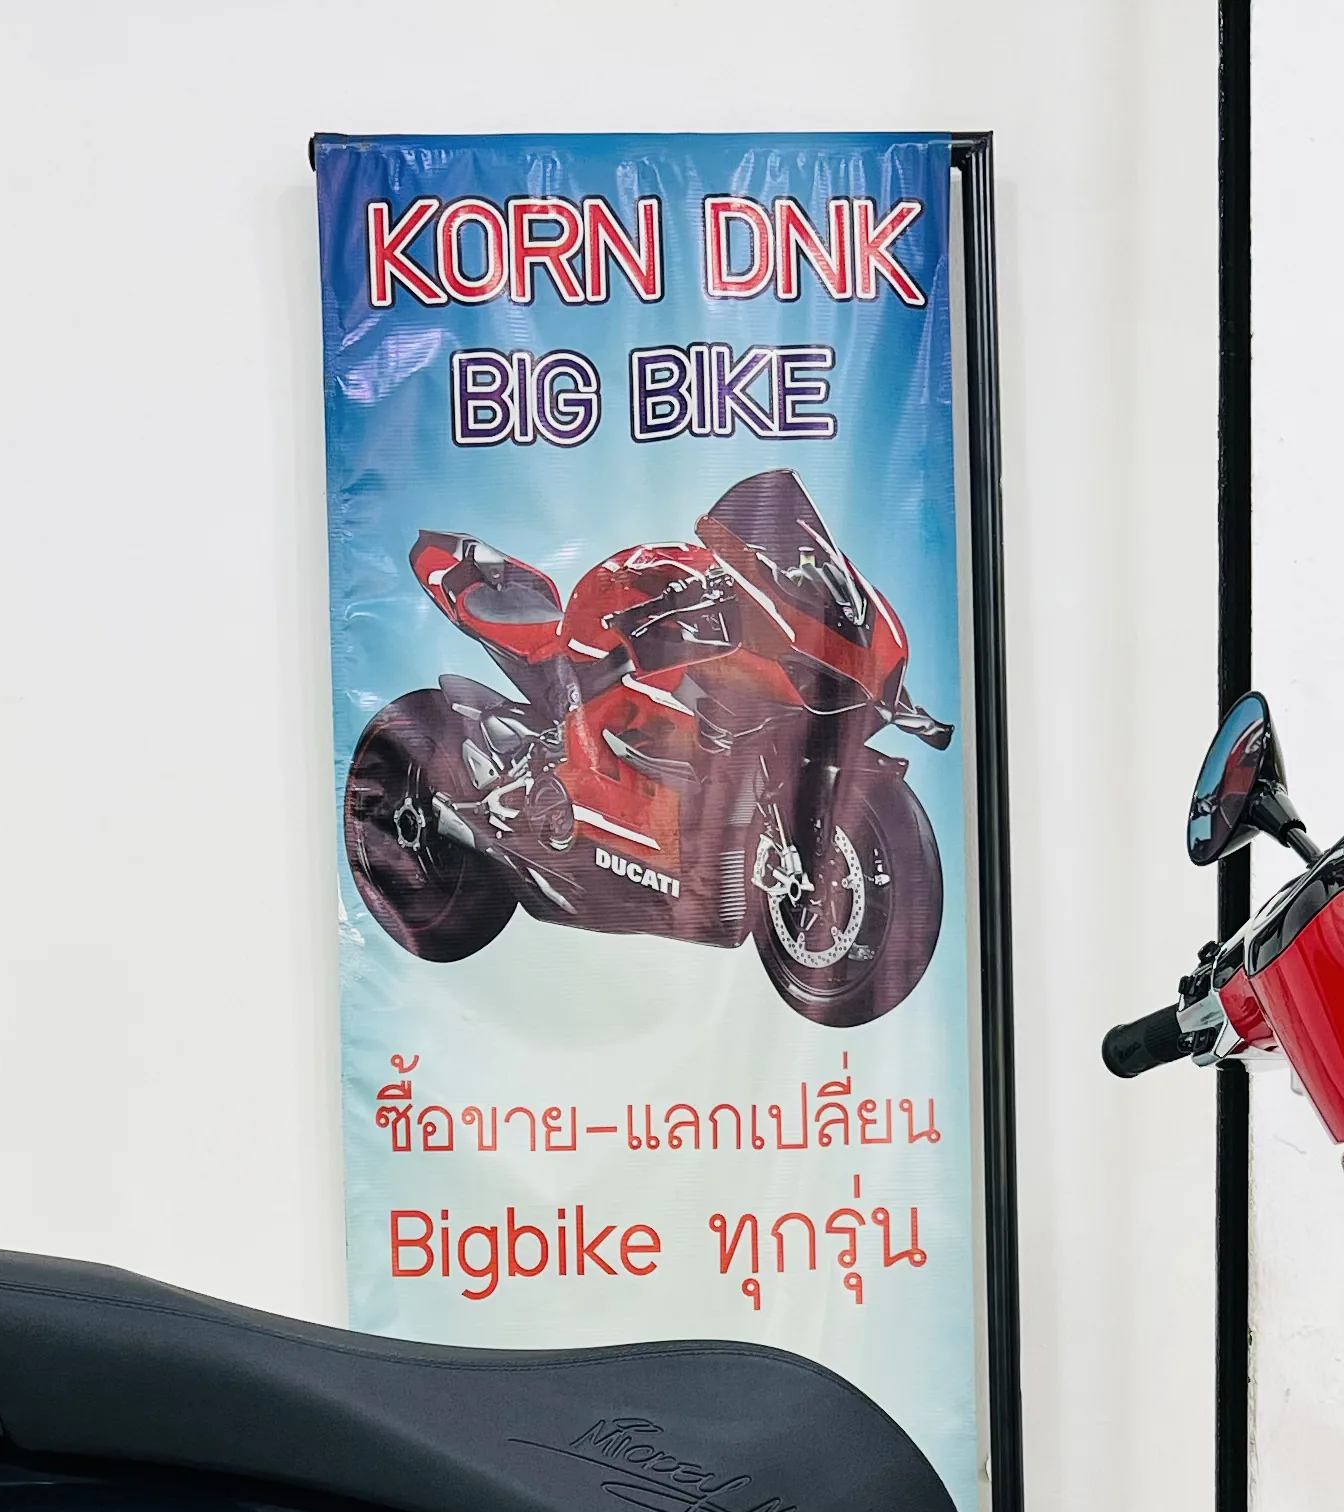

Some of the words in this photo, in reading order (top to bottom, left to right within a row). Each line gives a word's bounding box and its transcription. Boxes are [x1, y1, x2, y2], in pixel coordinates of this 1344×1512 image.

[366, 195, 663, 308] KORN
[704, 194, 926, 307] DNK
[451, 347, 601, 448] BIG
[629, 342, 838, 442] BIKE
[595, 847, 681, 899] DUCATI
[389, 1204, 662, 1300] Bigbike
[708, 1173, 928, 1310] ทุกรุ่น
